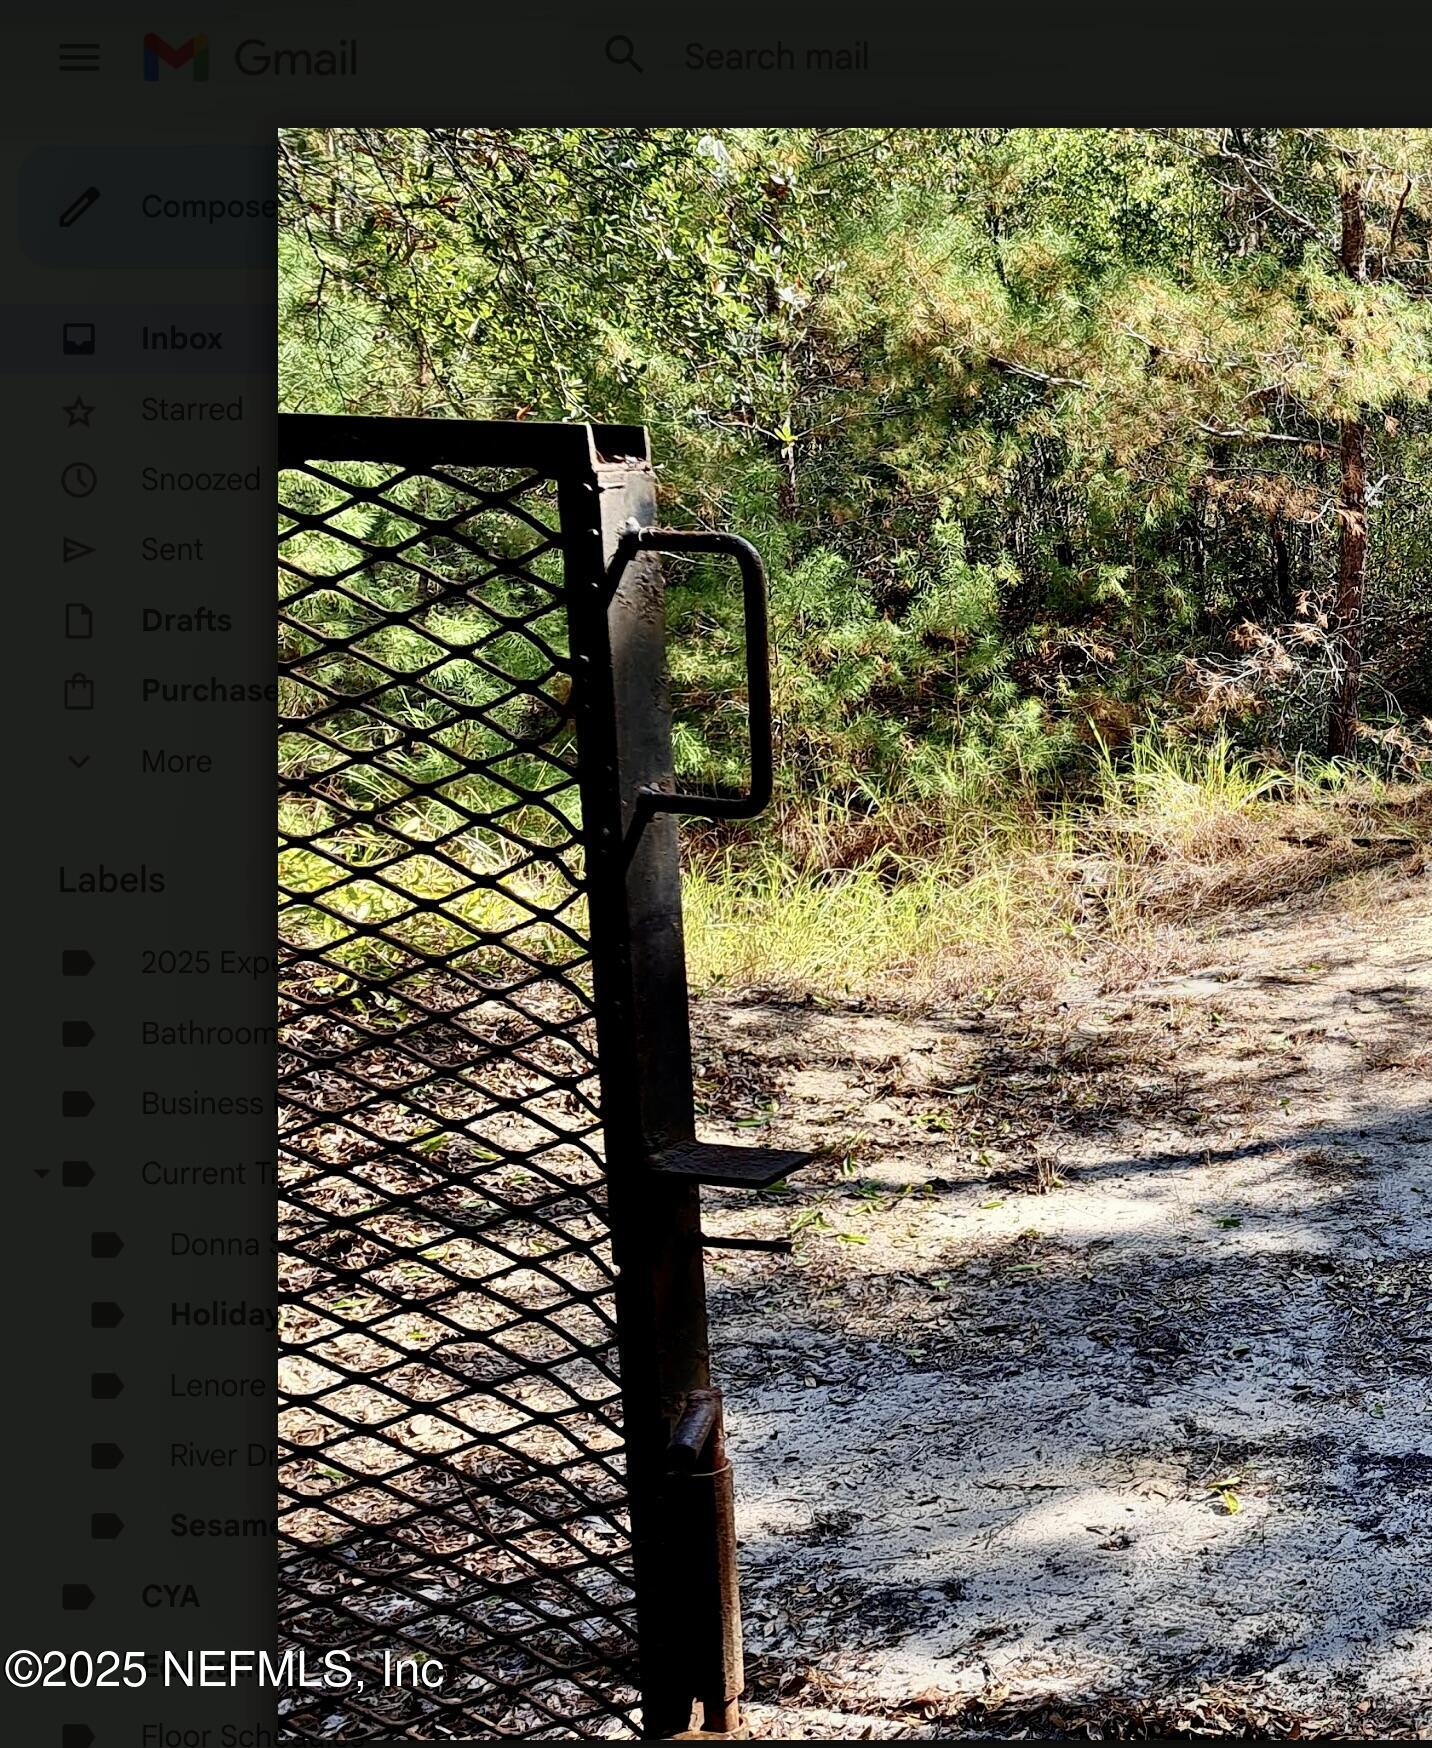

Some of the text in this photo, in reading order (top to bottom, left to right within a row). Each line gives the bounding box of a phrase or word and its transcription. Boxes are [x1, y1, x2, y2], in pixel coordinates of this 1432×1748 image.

[235, 40, 357, 76] Gmail
[686, 41, 868, 70] Search mail
[142, 194, 275, 224] Compose
[143, 325, 223, 350] Inbox
[142, 396, 243, 421] Starred
[142, 466, 261, 491] Snoozed
[142, 537, 204, 561] Sent
[143, 607, 232, 632] Drafts
[143, 750, 212, 774] More
[60, 864, 166, 893] Labels
[142, 950, 274, 981] 2025 Exp
[143, 1090, 264, 1116] Business
[142, 1160, 246, 1185] Current
[172, 1233, 260, 1256] Donna
[172, 1374, 266, 1397] Lenore
[172, 1442, 238, 1467] River
[171, 1513, 274, 1537] Sesam
[142, 1584, 201, 1608] CYA
[144, 1724, 212, 1748] Floor
